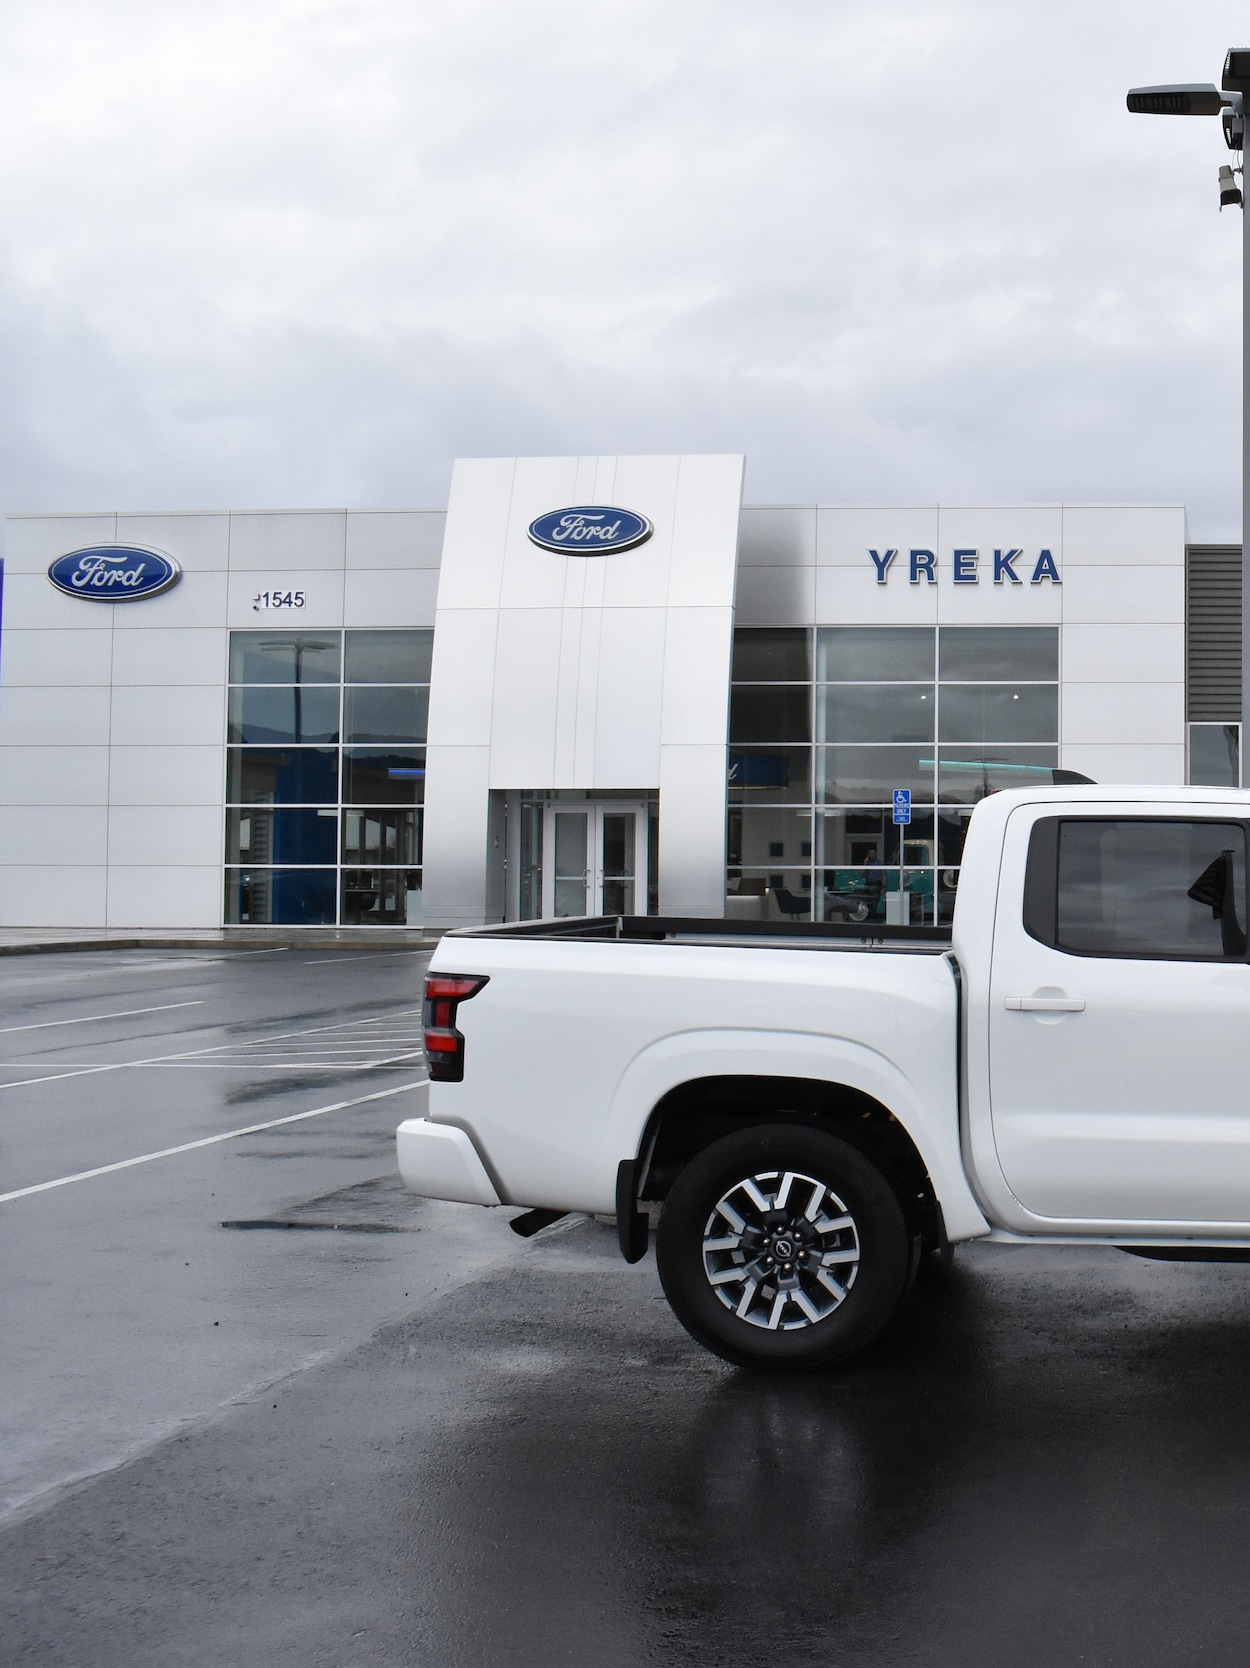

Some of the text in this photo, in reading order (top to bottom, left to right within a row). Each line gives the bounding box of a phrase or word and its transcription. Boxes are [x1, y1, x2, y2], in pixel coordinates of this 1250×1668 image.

[552, 513, 622, 541] Ford
[71, 555, 147, 587] Ford
[866, 548, 1063, 584] YREKA
[261, 591, 305, 608] 1545
